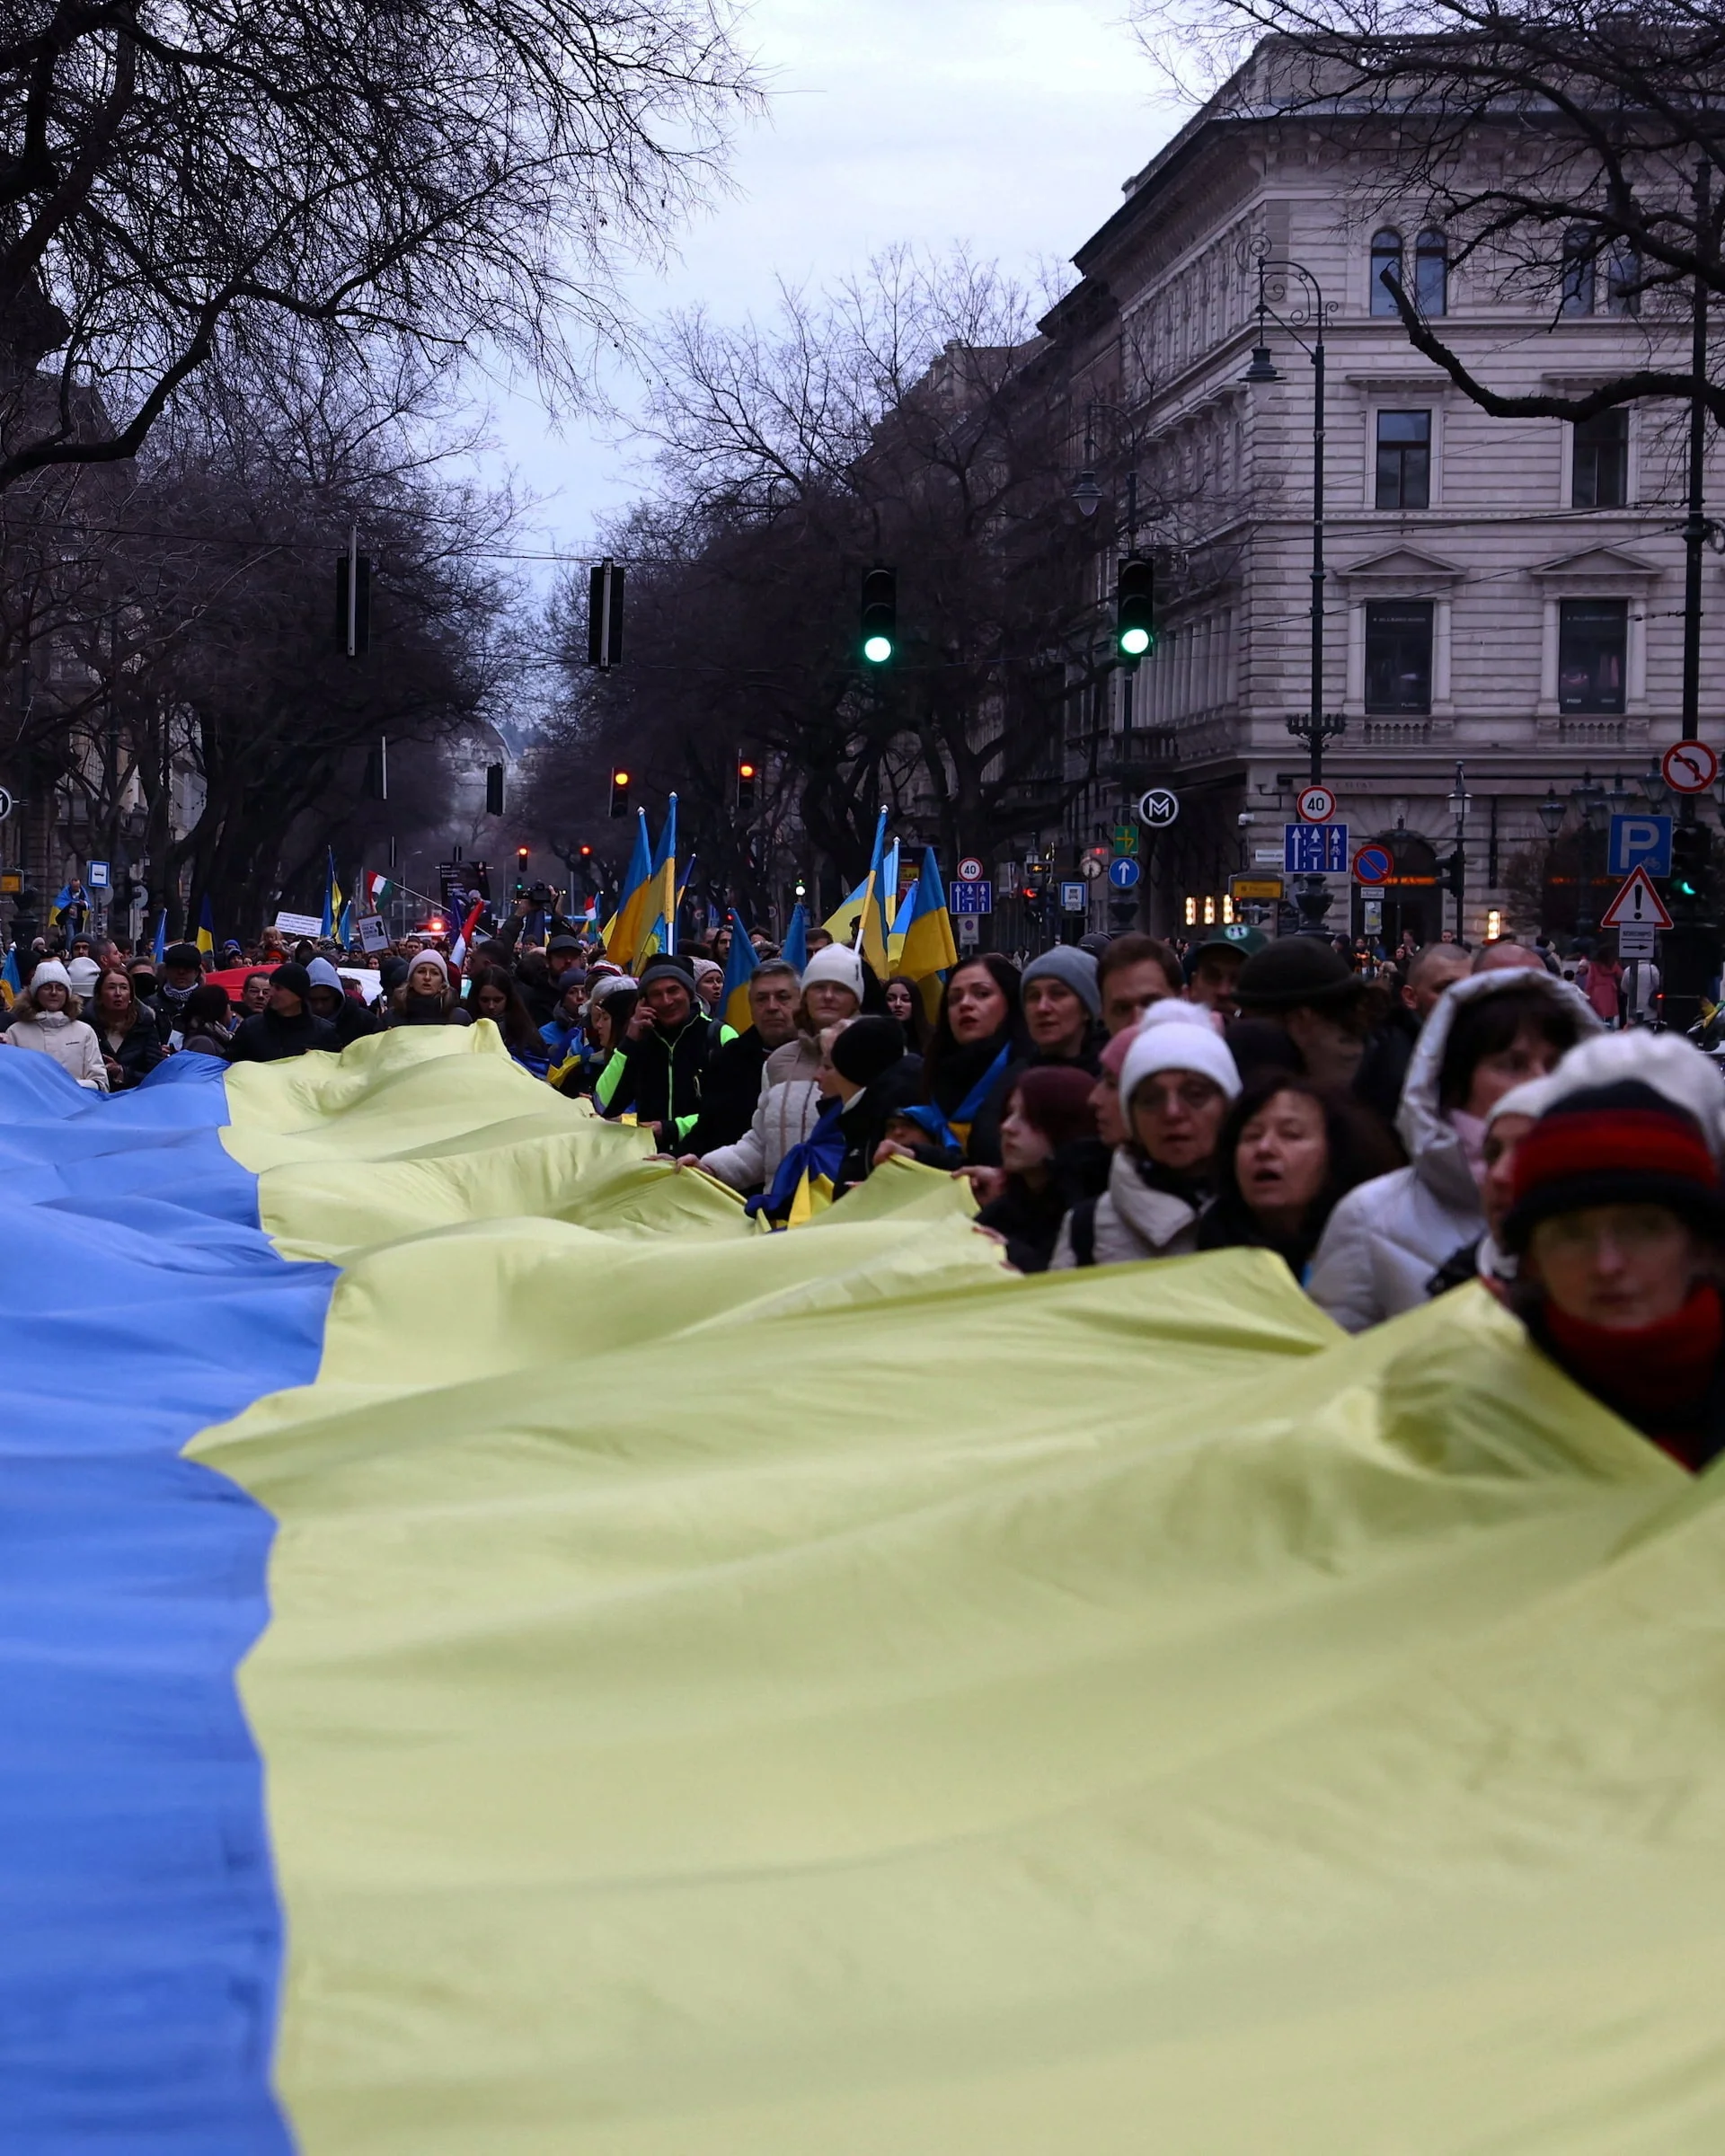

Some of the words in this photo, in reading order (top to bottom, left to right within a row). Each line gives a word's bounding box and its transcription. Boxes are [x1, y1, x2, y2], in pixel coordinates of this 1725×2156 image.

[1149, 797, 1170, 817] M
[1307, 797, 1325, 811] 40
[1620, 820, 1659, 869] P
[964, 865, 977, 875] 40
